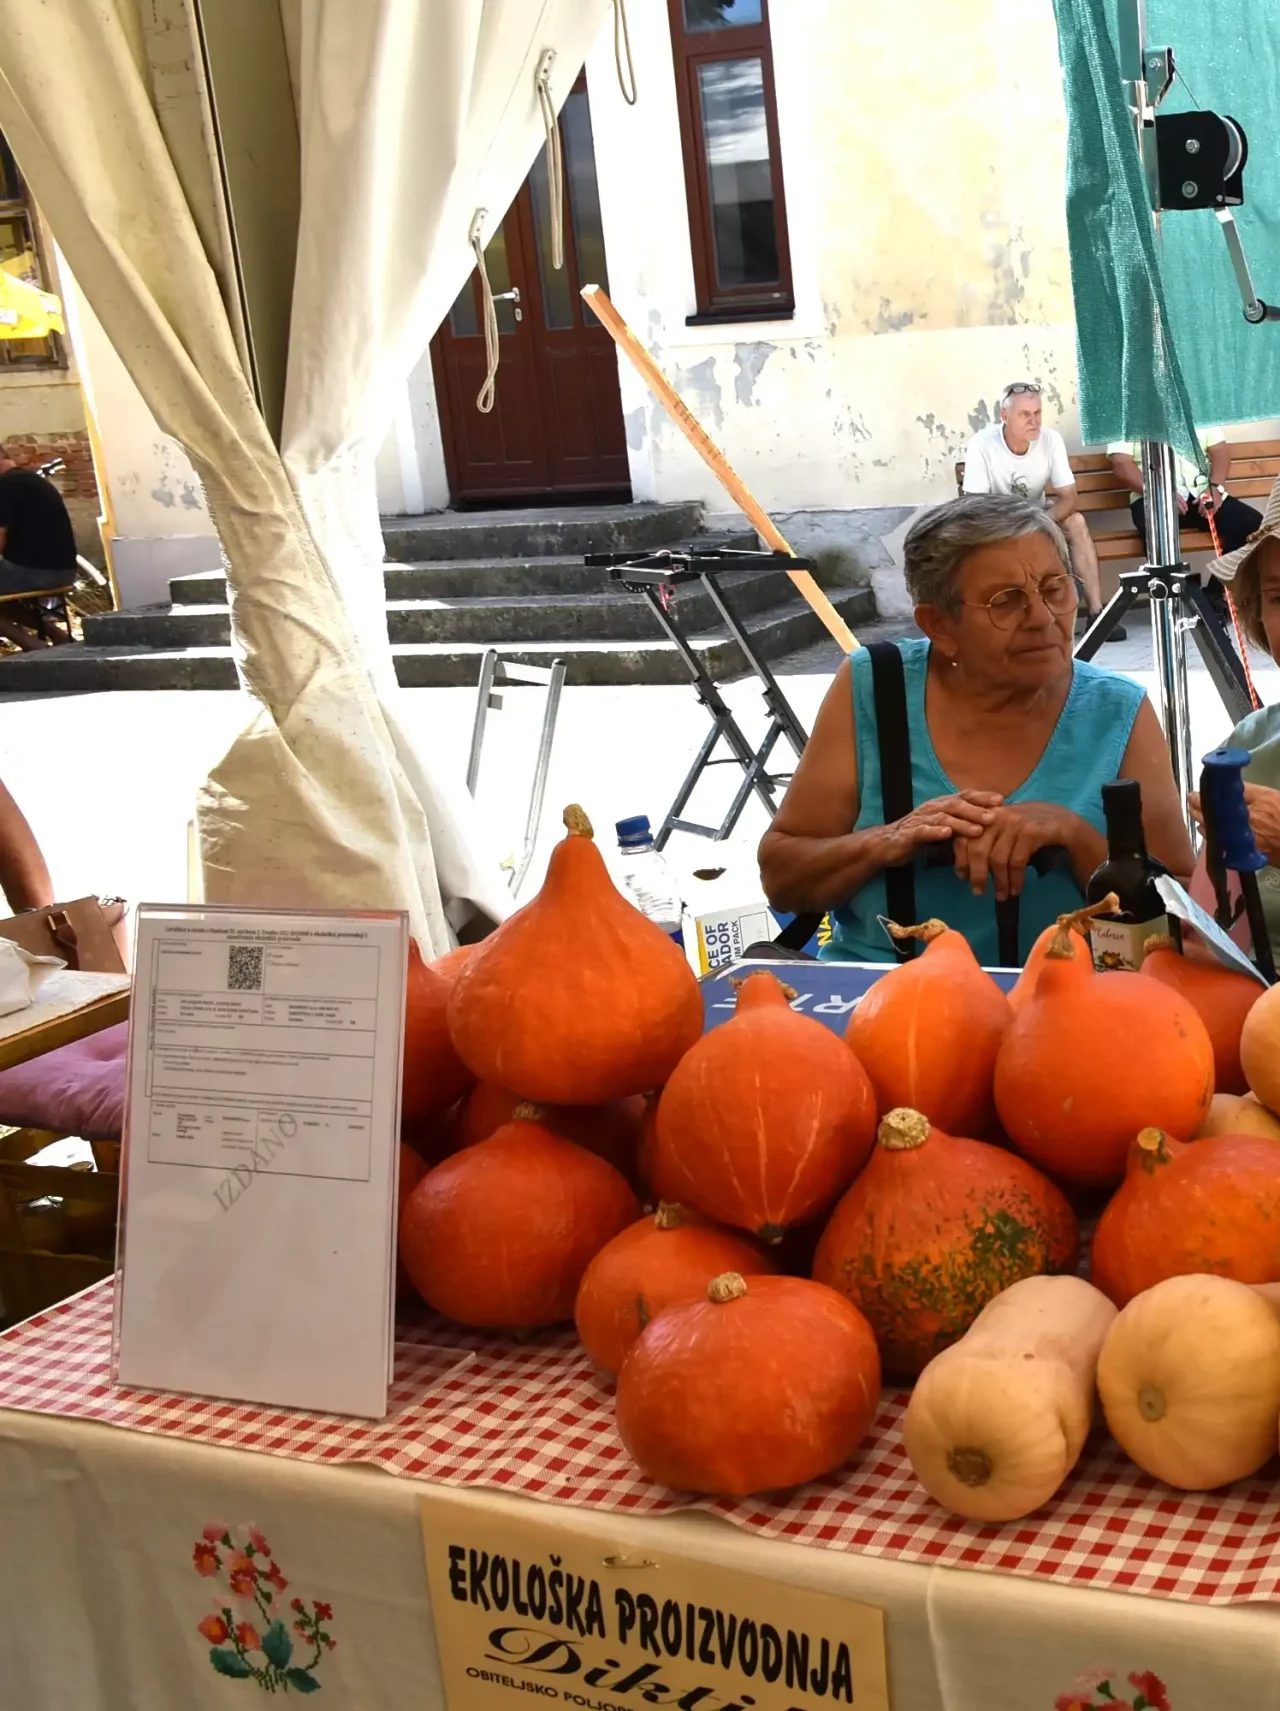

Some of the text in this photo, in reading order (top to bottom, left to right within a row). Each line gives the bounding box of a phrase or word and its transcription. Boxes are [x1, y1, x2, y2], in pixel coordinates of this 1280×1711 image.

[705, 925, 718, 946] OF
[731, 920, 741, 945] PACK
[213, 1113, 298, 1212] IZDANO
[448, 1545, 854, 1704] EKOLOŠKA PROIZVODNJA
[466, 1667, 558, 1698] OBITELJSKO
